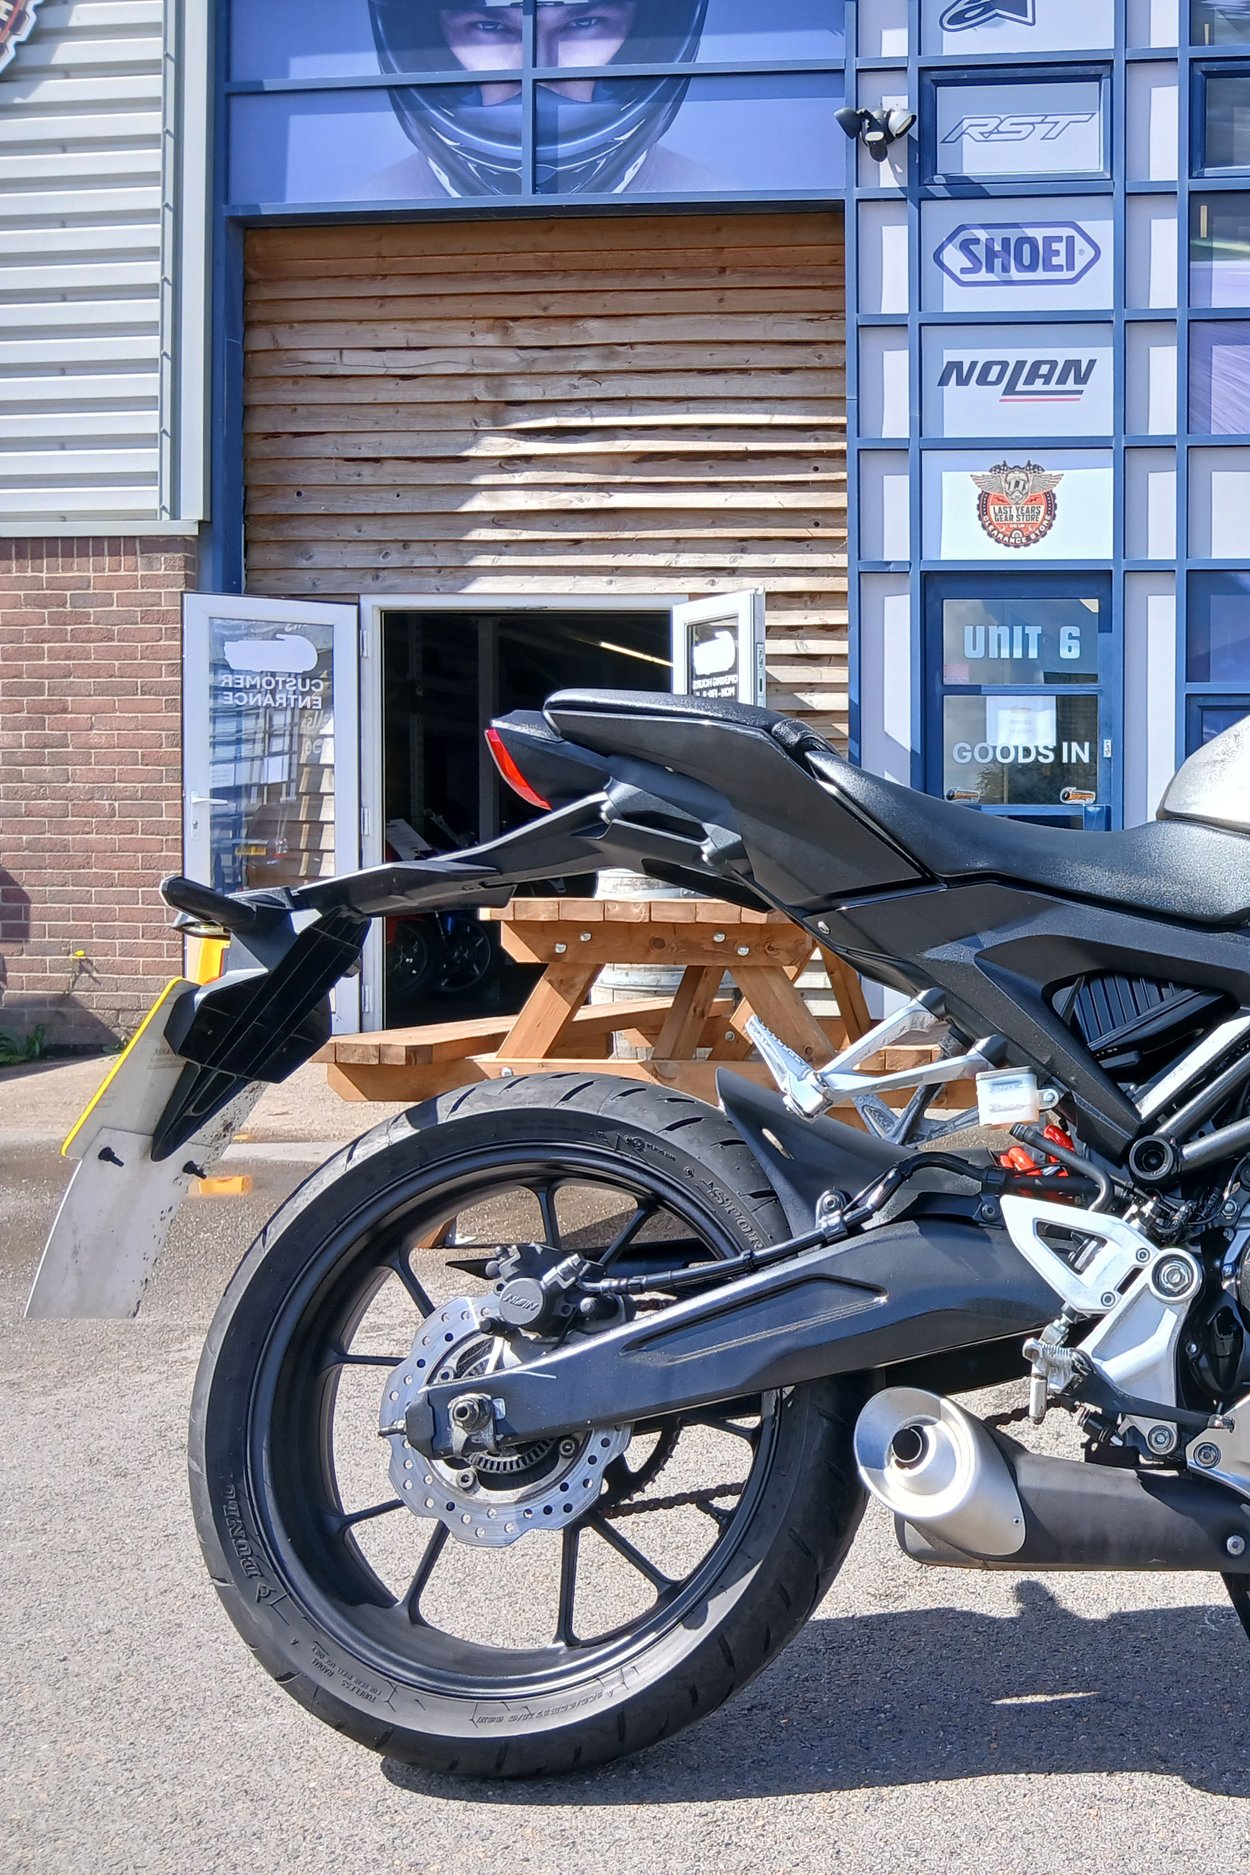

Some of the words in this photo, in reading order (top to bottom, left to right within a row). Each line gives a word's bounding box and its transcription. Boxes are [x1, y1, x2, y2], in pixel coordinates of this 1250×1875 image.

[940, 113, 1096, 144] RST
[958, 235, 1076, 274] SHOEI
[937, 359, 1097, 396] NOLAN
[993, 506, 1013, 515] LAST
[1015, 505, 1041, 515] YEARS
[994, 514, 1014, 522] GEAR
[1016, 514, 1040, 522] STORE
[983, 515, 1027, 543] CLEARANCE
[1059, 625, 1081, 659] 6
[952, 742, 1055, 764] GOODS
[1062, 742, 1090, 763] IN
